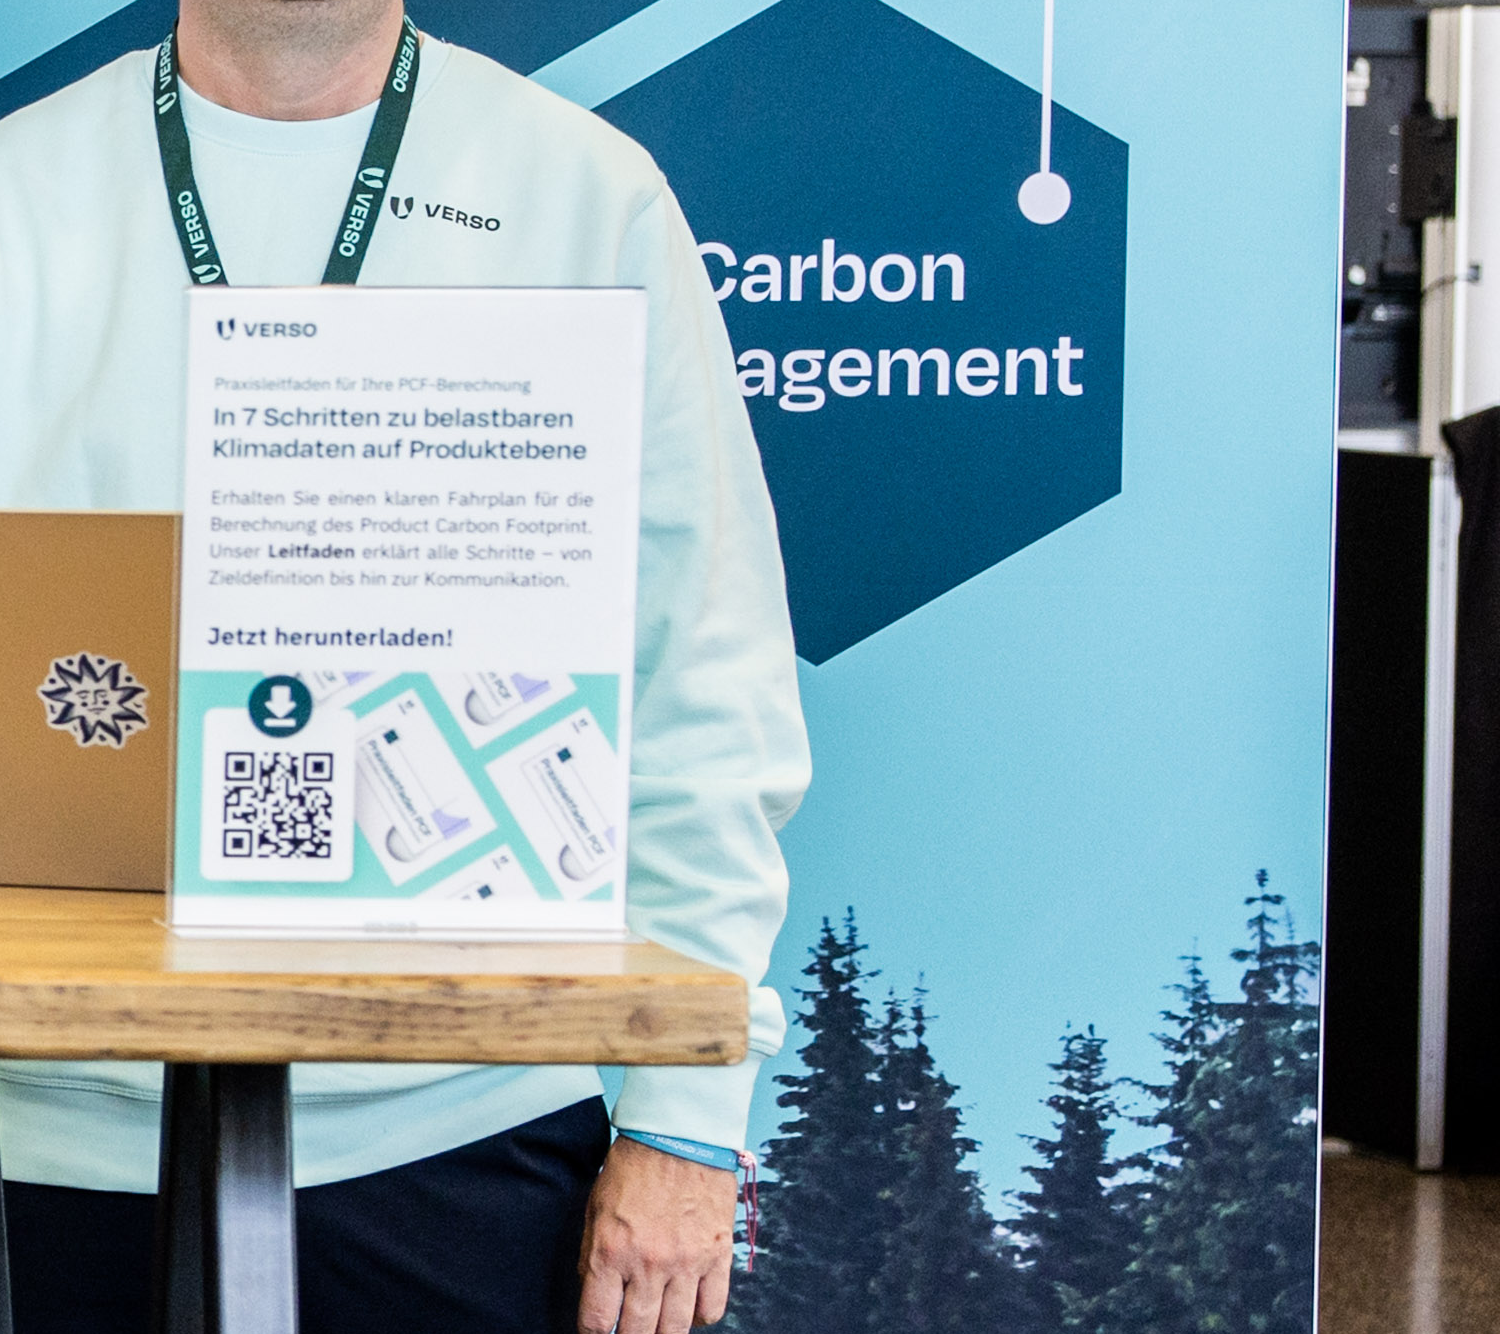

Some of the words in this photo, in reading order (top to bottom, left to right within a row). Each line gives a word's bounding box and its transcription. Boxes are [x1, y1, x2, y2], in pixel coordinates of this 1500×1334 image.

[392, 35, 416, 93] VERSO
[177, 190, 209, 260] VERSO
[339, 192, 373, 258] VERSO
[425, 204, 500, 231] VERSO
[697, 239, 966, 303] Carbon
[244, 323, 317, 337] VERSO
[736, 336, 1084, 412] agement
[215, 377, 331, 391] Praxisleitfaden
[335, 377, 356, 391] für
[362, 378, 394, 391] Ihre
[399, 378, 531, 395] PCF-Berechnung
[214, 408, 235, 425] In
[243, 408, 257, 425] 7
[264, 408, 380, 427] Schritten
[388, 412, 416, 427] zu
[424, 409, 573, 428] belastbaren
[213, 439, 355, 458] Klimadaten
[362, 439, 402, 458] auf
[410, 440, 586, 460] Produktebene
[211, 490, 285, 505] Erhalten
[294, 490, 320, 506] Sie
[328, 494, 376, 506] einen
[385, 491, 439, 506] klaren
[448, 491, 526, 509] Fahrplan
[535, 492, 558, 507] für
[567, 493, 594, 507] die
[211, 516, 317, 536] Berechnung
[323, 518, 354, 532] des
[361, 517, 429, 533] Product
[436, 518, 499, 533] Carbon
[506, 518, 591, 536] Footprint.
[210, 544, 260, 559] Unser
[269, 544, 354, 558] Leitfaden
[362, 545, 419, 559] erklärt
[427, 545, 459, 560] alle
[466, 545, 535, 560] Schritte
[560, 549, 592, 561] von
[208, 570, 324, 586] Zieldefinition
[330, 571, 354, 586] bis
[360, 571, 386, 585] hin
[392, 575, 418, 586] zur
[424, 572, 570, 587] Kommunikation.
[208, 627, 266, 645] Jetzt
[276, 628, 452, 646] herunterladen!
